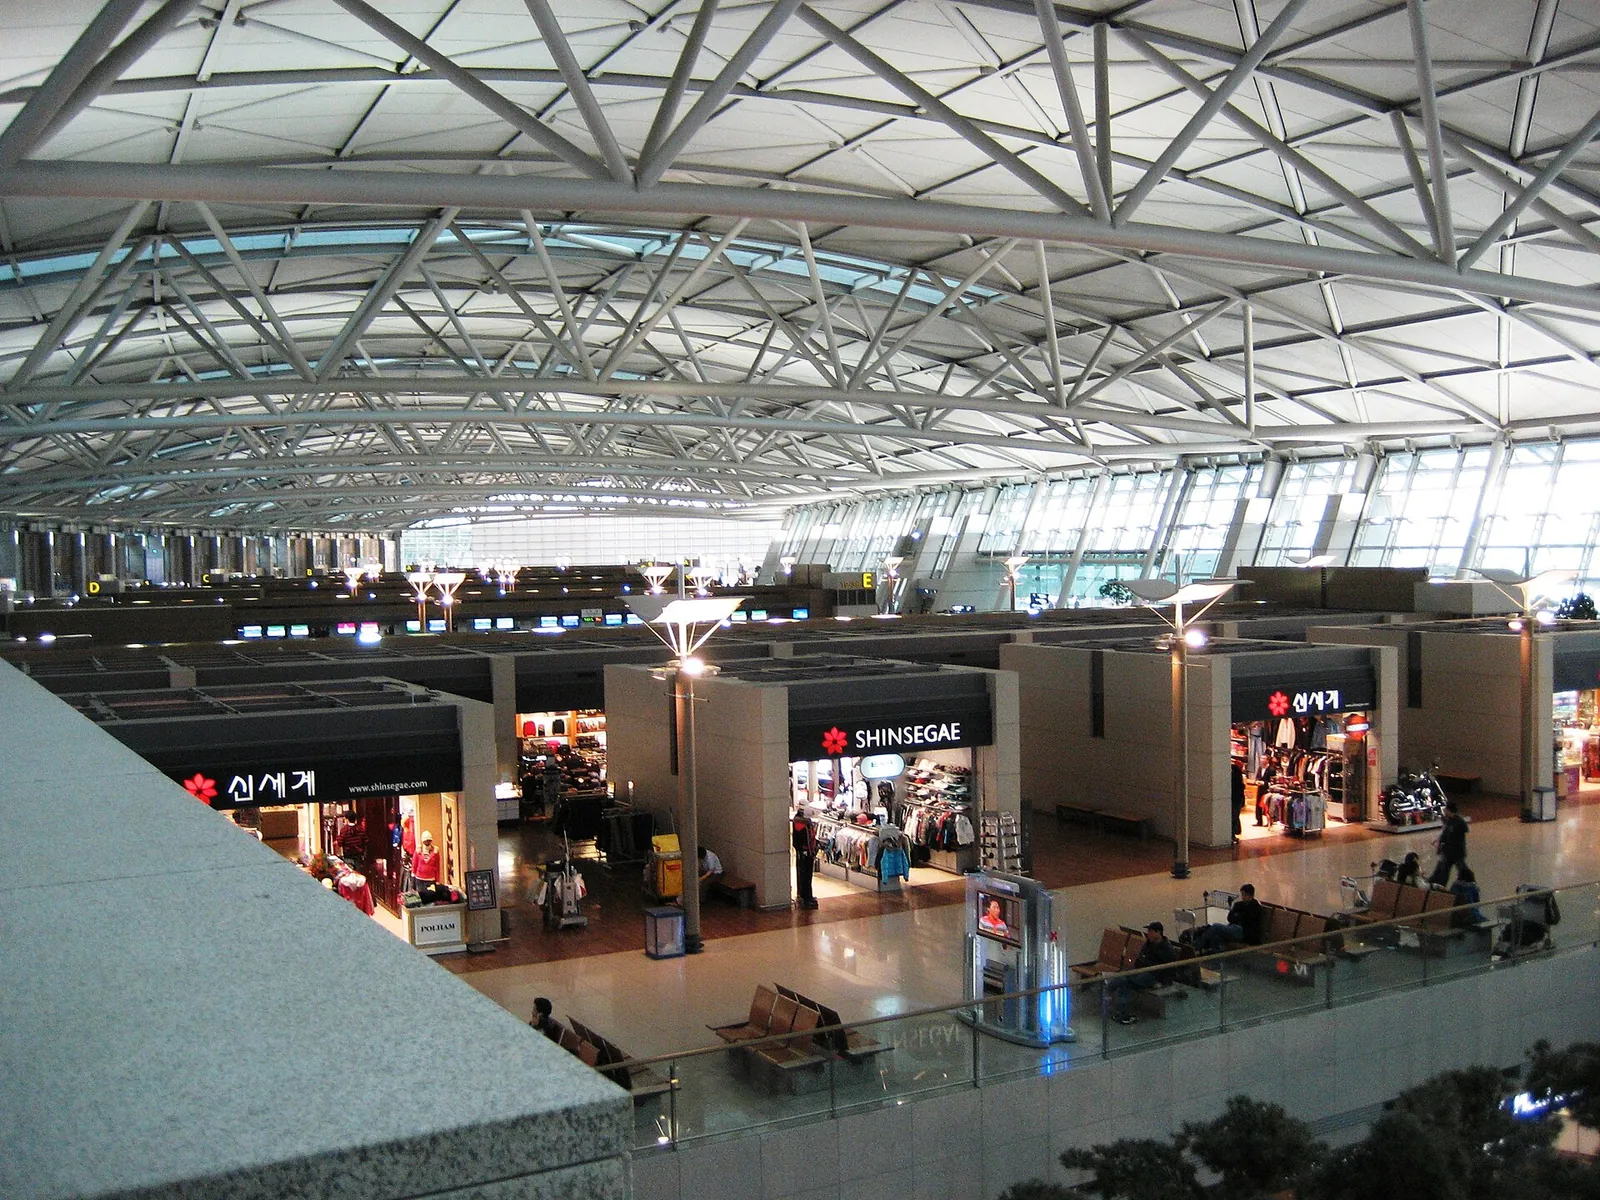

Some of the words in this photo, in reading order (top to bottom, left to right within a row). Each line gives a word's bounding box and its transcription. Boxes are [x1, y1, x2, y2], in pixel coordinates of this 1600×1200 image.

[202, 574, 210, 583] C
[862, 572, 872, 588] E
[89, 582, 100, 594] D
[855, 722, 961, 749] SHINSEGAE
[227, 770, 316, 802] 신세계
[348, 780, 428, 794] www.shinsegae.com
[420, 922, 456, 933] POLHAM
